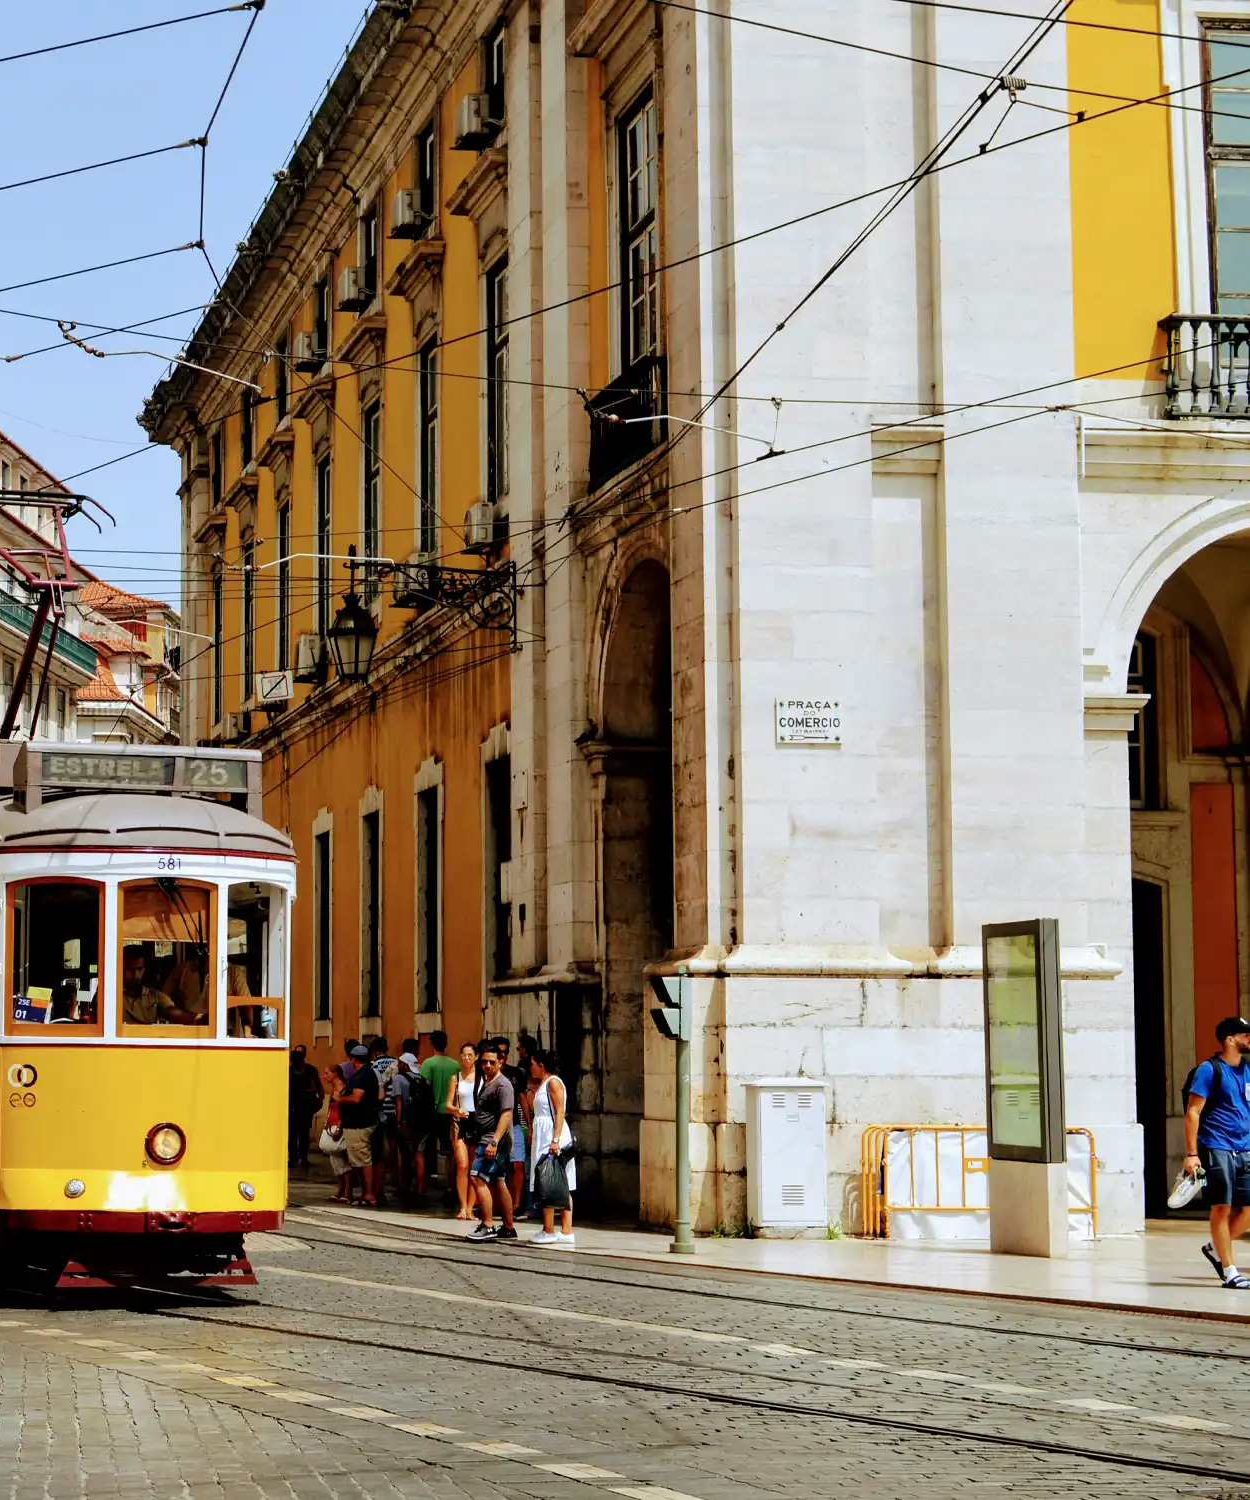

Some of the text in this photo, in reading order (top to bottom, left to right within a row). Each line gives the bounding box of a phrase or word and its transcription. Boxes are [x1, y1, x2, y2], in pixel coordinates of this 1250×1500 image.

[787, 701, 832, 712] PRAÇA
[779, 717, 841, 728] COMERCIO
[50, 756, 228, 785] ESTRELA 25
[157, 857, 181, 870] 581
[15, 1009, 27, 1019] 01
